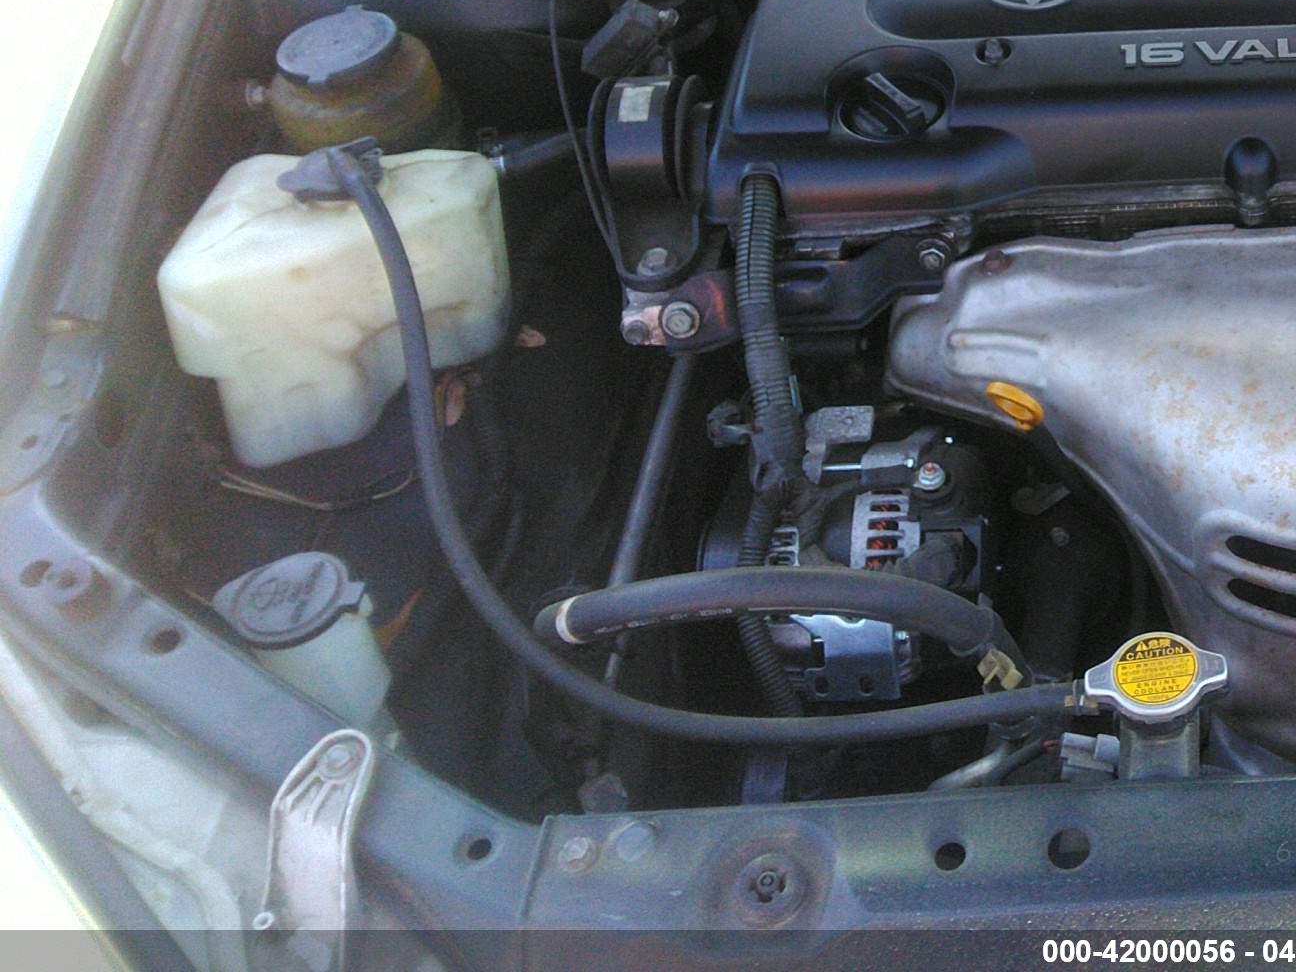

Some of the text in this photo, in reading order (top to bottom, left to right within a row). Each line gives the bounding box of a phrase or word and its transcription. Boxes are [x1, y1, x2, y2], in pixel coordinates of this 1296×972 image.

[1119, 41, 1186, 70] 16
[1126, 646, 1184, 660] CAUTION
[1137, 679, 1177, 688] ENGINE
[1135, 685, 1180, 694] COOLANT
